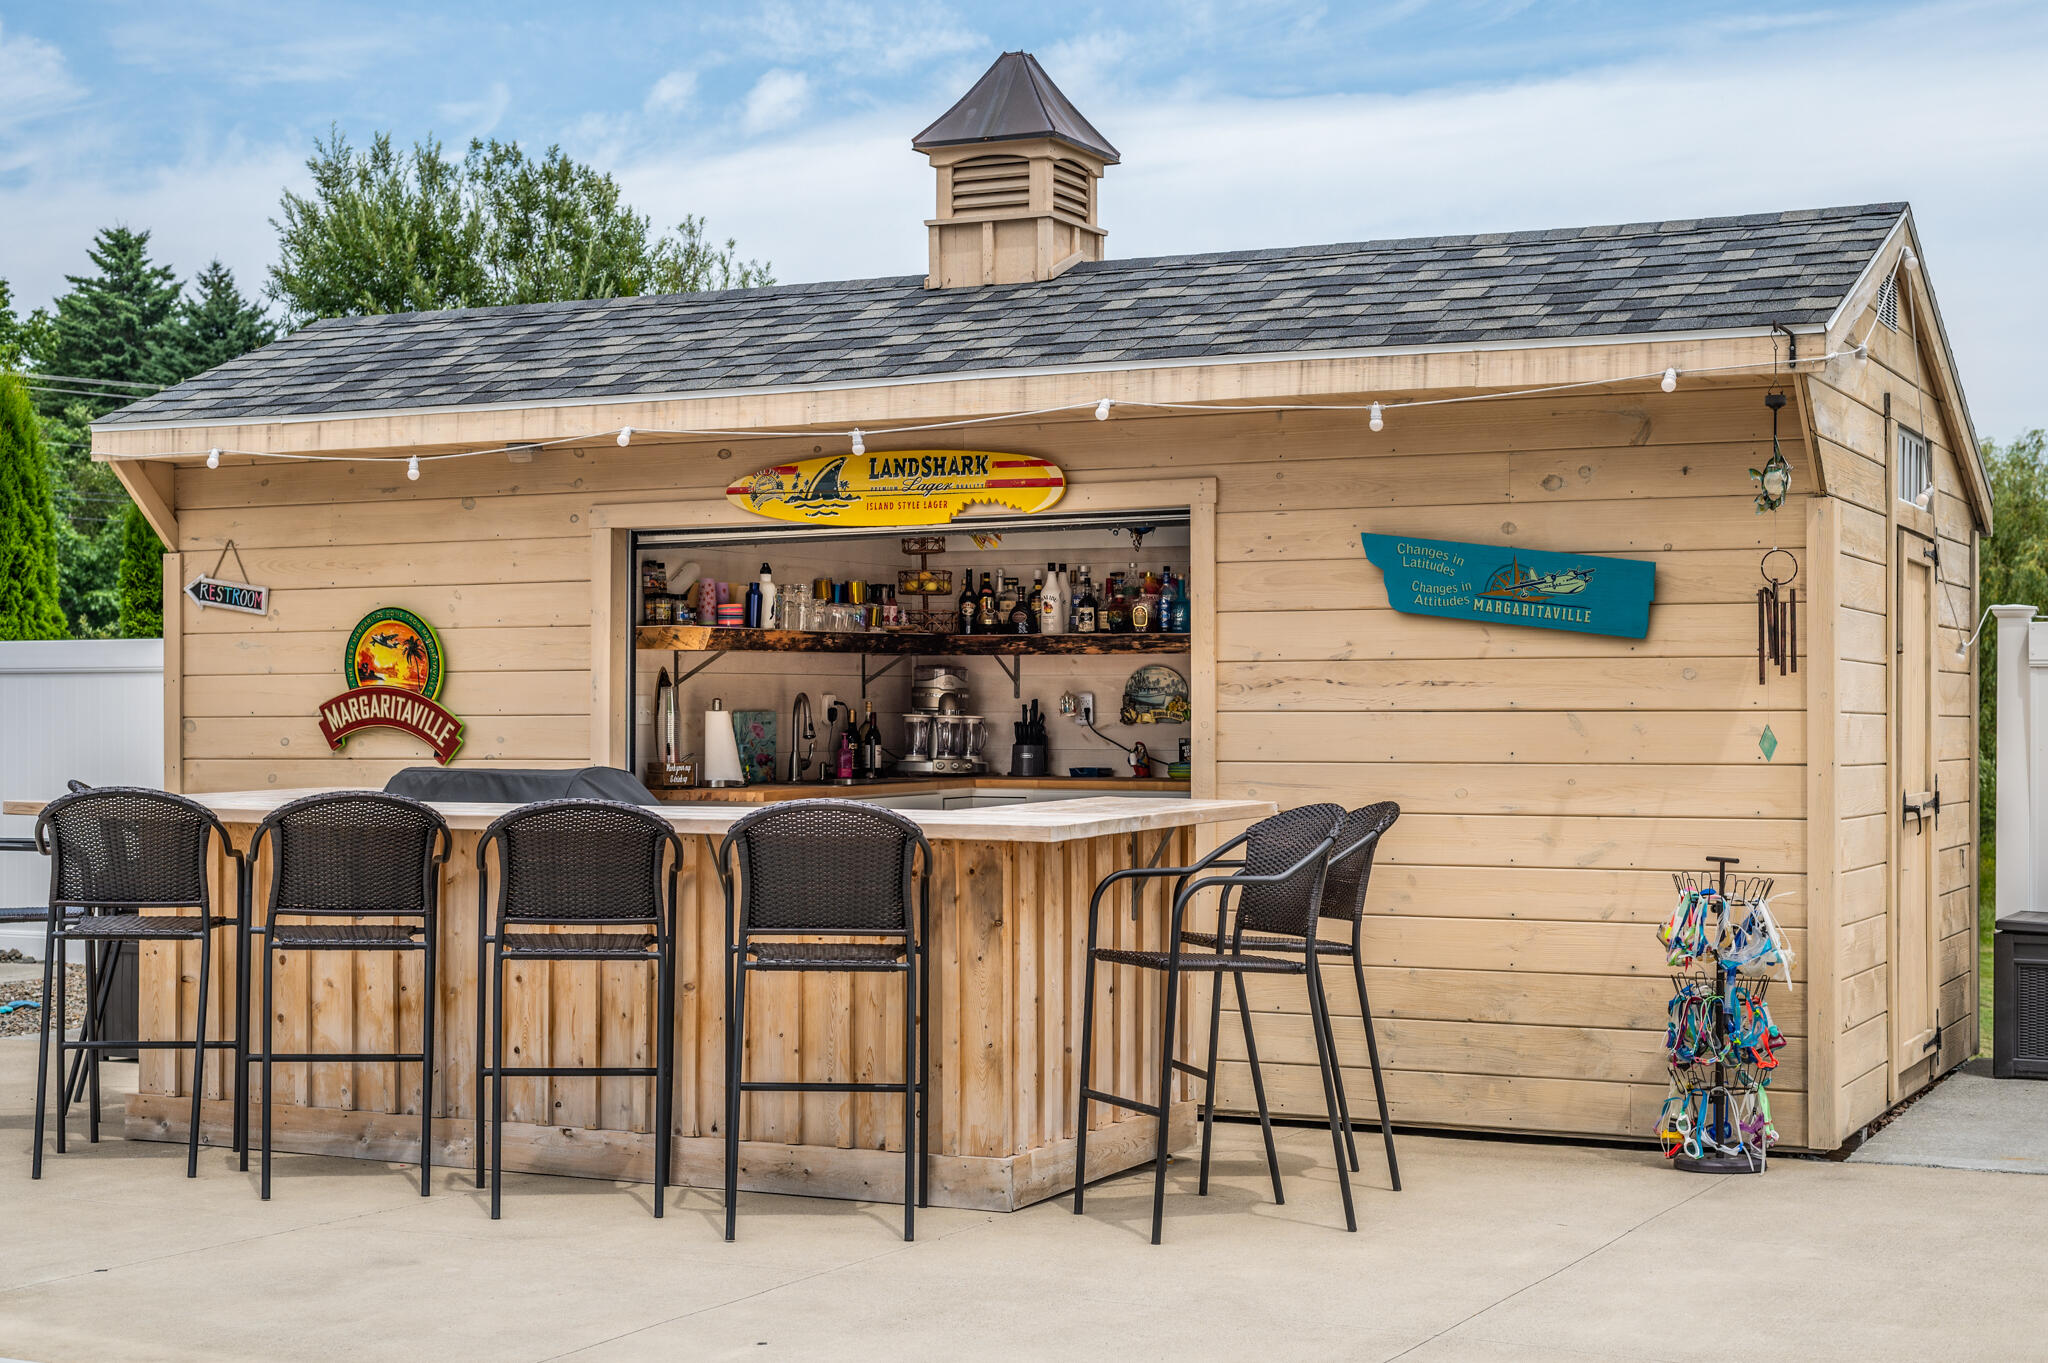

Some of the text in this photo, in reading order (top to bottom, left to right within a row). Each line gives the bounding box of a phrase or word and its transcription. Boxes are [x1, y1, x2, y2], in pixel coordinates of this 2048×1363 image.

[869, 455, 989, 480] LANDSHARK
[902, 476, 954, 497] Lager
[866, 500, 948, 511] ISLAND STYLE LAGER
[1397, 543, 1465, 567] Changes in
[1402, 556, 1456, 577] Latitudes
[200, 583, 263, 609] RESTROOM
[1411, 580, 1472, 596] Changes in
[1414, 594, 1470, 607] Attitudes
[1473, 599, 1592, 623] MARGARITAVILLE
[324, 694, 456, 748] MARGARITAVILLE
